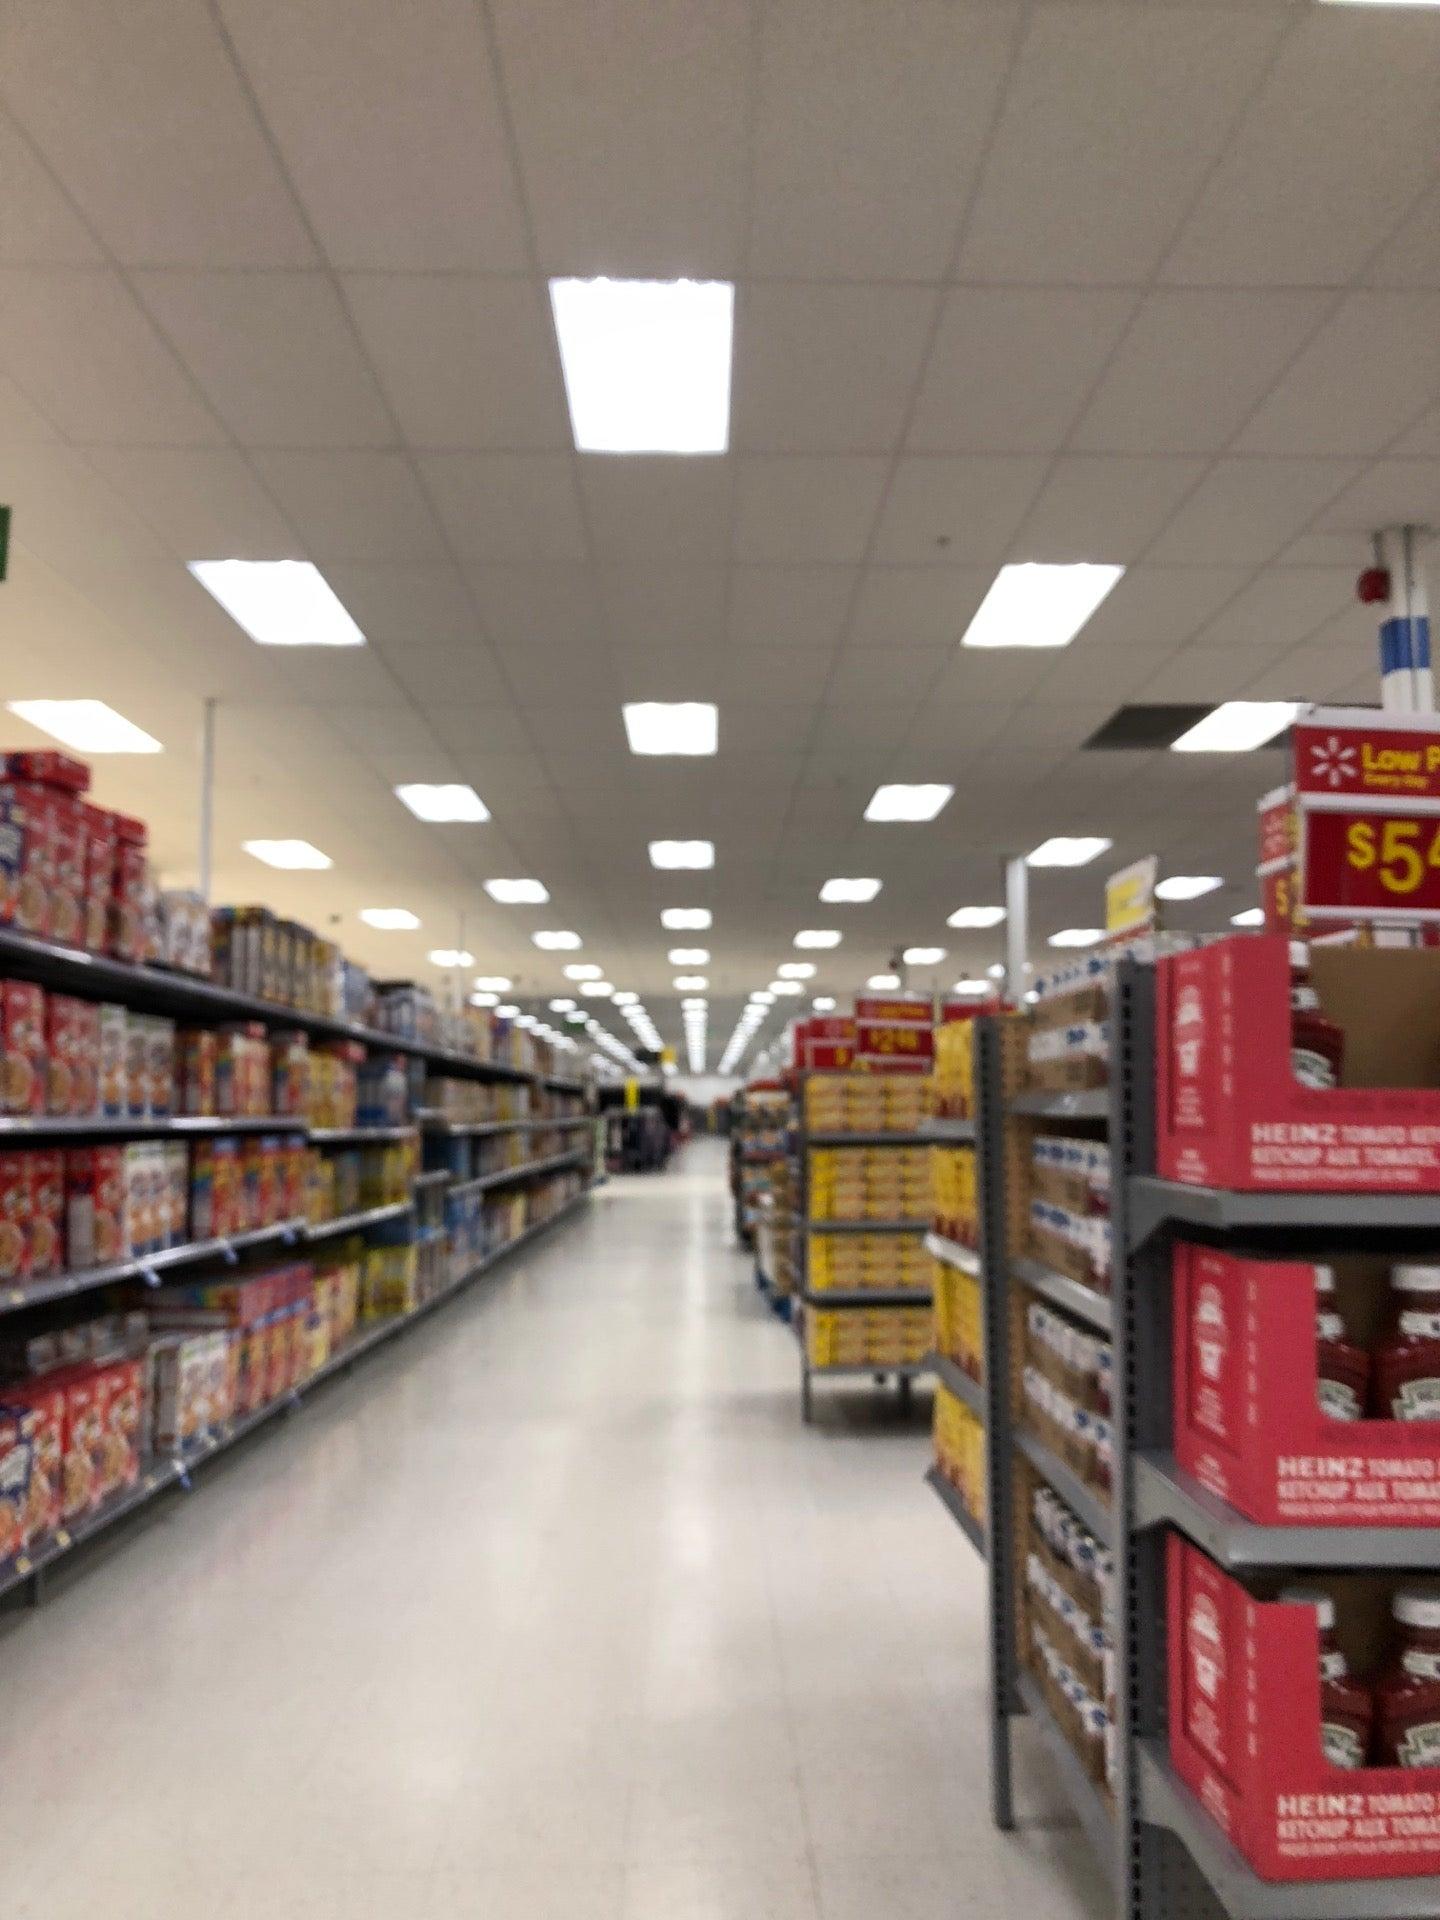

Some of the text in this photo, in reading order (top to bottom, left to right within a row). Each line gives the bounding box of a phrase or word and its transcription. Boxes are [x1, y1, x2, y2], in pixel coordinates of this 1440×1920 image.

[1252, 1123, 1336, 1144] HEINZ
[1277, 1456, 1363, 1478] HEINZ
[1277, 1794, 1363, 1817] HEINZ
